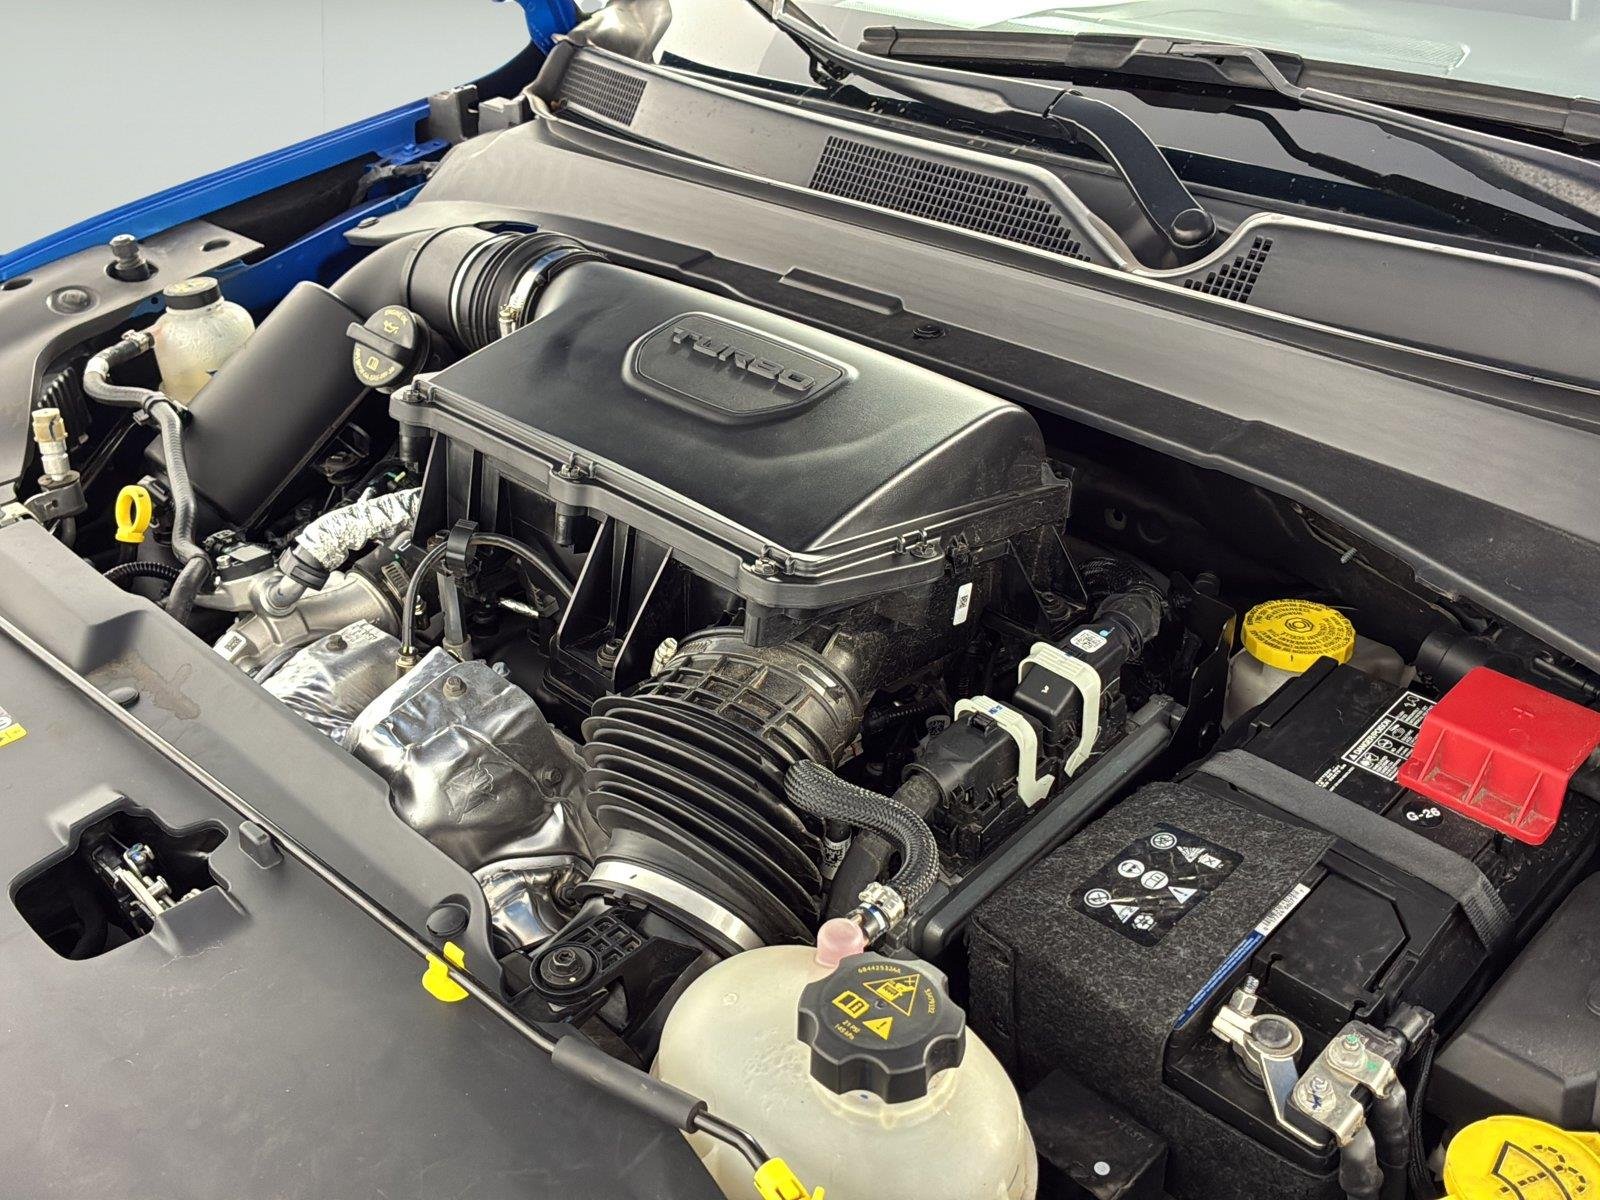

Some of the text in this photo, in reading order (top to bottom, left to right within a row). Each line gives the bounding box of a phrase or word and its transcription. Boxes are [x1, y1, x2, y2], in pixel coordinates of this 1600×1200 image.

[672, 326, 816, 392] TURBO
[1353, 718, 1392, 755] DANGER/POISON
[1406, 807, 1441, 822] G-26
